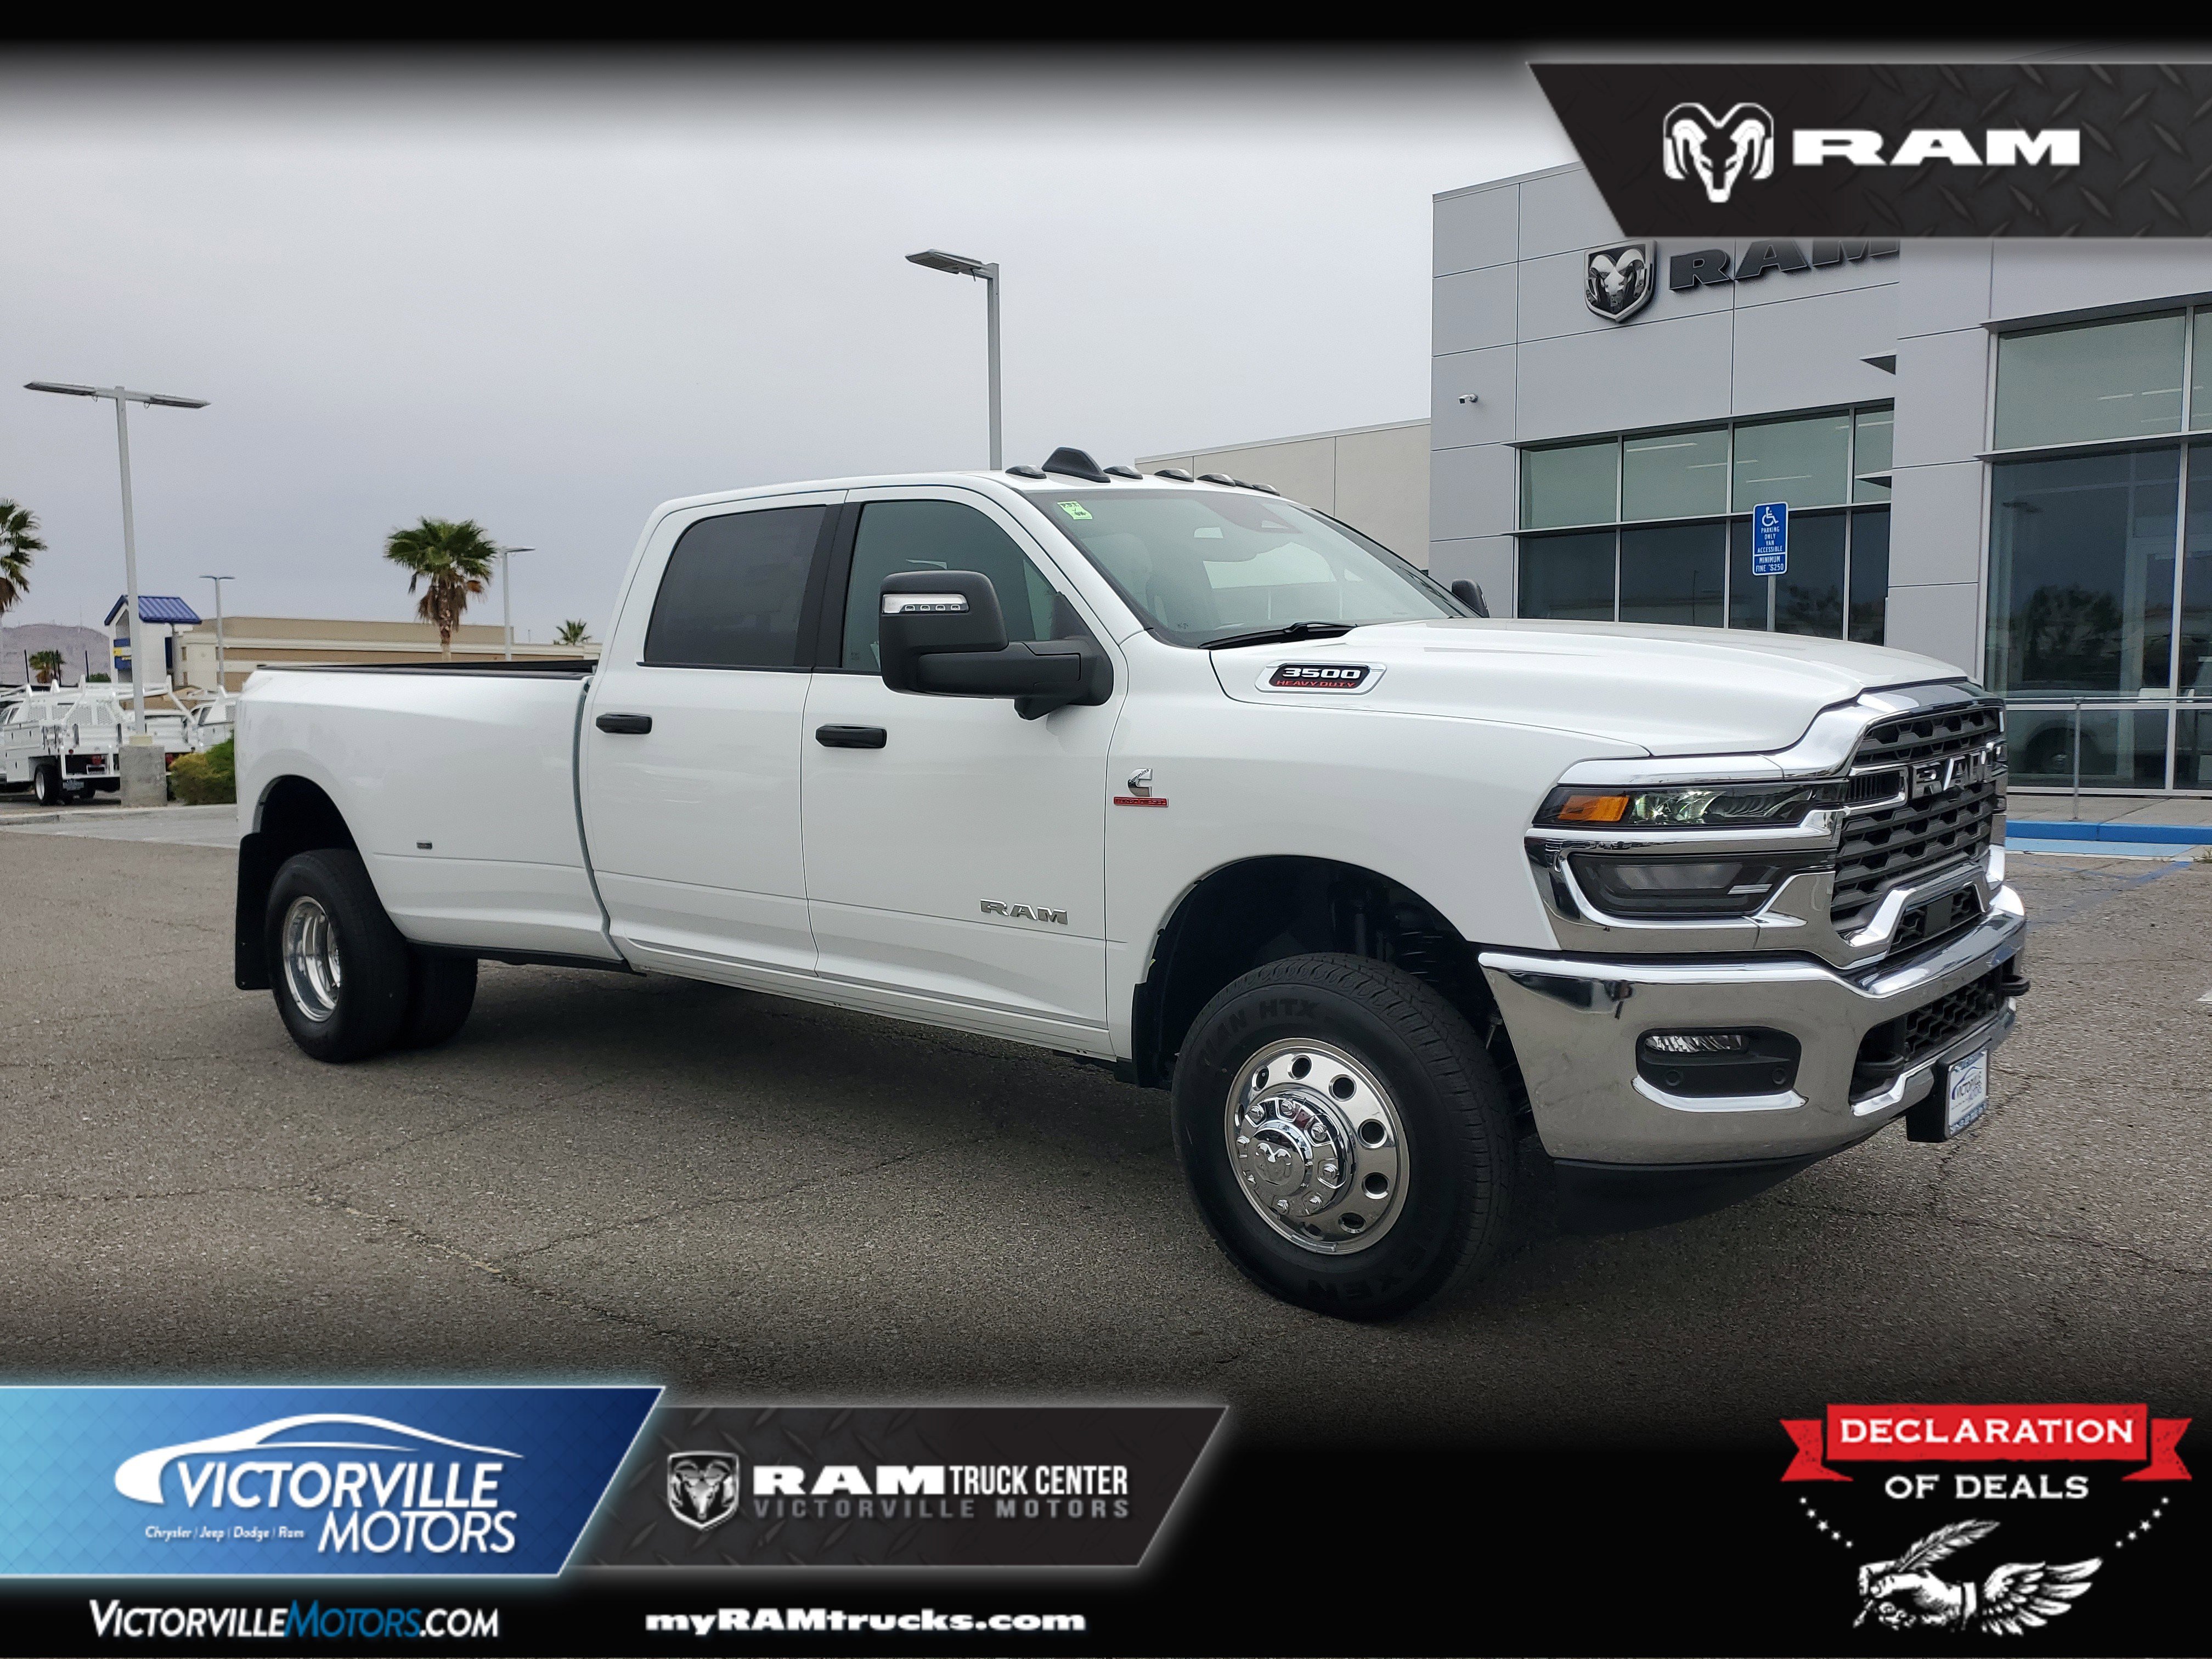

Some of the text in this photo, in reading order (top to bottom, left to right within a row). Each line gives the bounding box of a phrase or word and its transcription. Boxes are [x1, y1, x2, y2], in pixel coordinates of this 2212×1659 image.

[1669, 238, 1900, 290] RAM
[1757, 545, 1783, 554] ACCESSIBLE
[1759, 556, 1781, 564] MINIMUM
[1769, 563, 1784, 572] $250
[1282, 668, 1361, 679] 3500
[1127, 768, 1149, 784] Cummins
[1912, 749, 1995, 800] RAM
[980, 899, 1068, 925] RAM
[1259, 998, 1321, 1020] HTX
